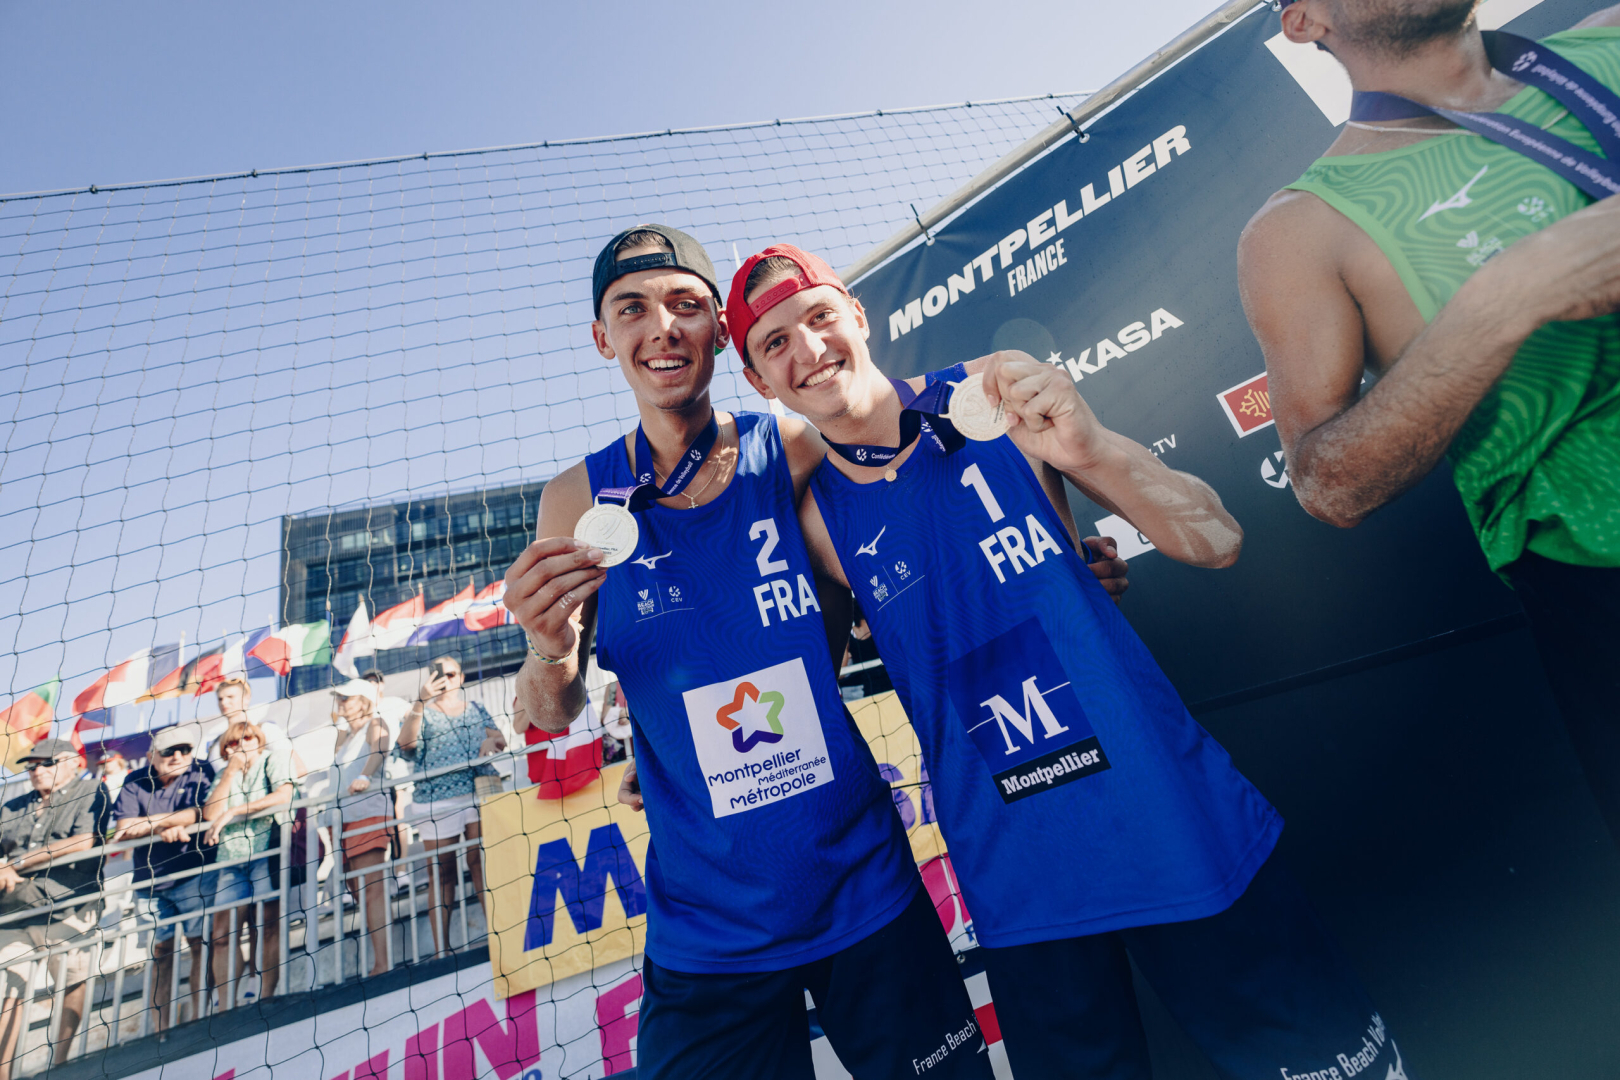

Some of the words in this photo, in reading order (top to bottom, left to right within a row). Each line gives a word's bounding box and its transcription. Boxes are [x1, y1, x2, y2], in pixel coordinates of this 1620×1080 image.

[889, 124, 1192, 342] MONTPELLIER
[1006, 237, 1068, 298] FRANCE
[1046, 307, 1185, 384] KASA
[1149, 433, 1177, 457] .TV
[959, 462, 1006, 524] 1
[748, 517, 790, 578] 2
[900, 570, 911, 581] CEV
[978, 513, 1064, 585] FRA
[752, 573, 822, 628] FRA
[979, 675, 1070, 756] M
[1001, 748, 1101, 796] Montpellier
[912, 1044, 949, 1076] France
[945, 1018, 977, 1051] Beach
[1336, 1035, 1380, 1079] Beach
